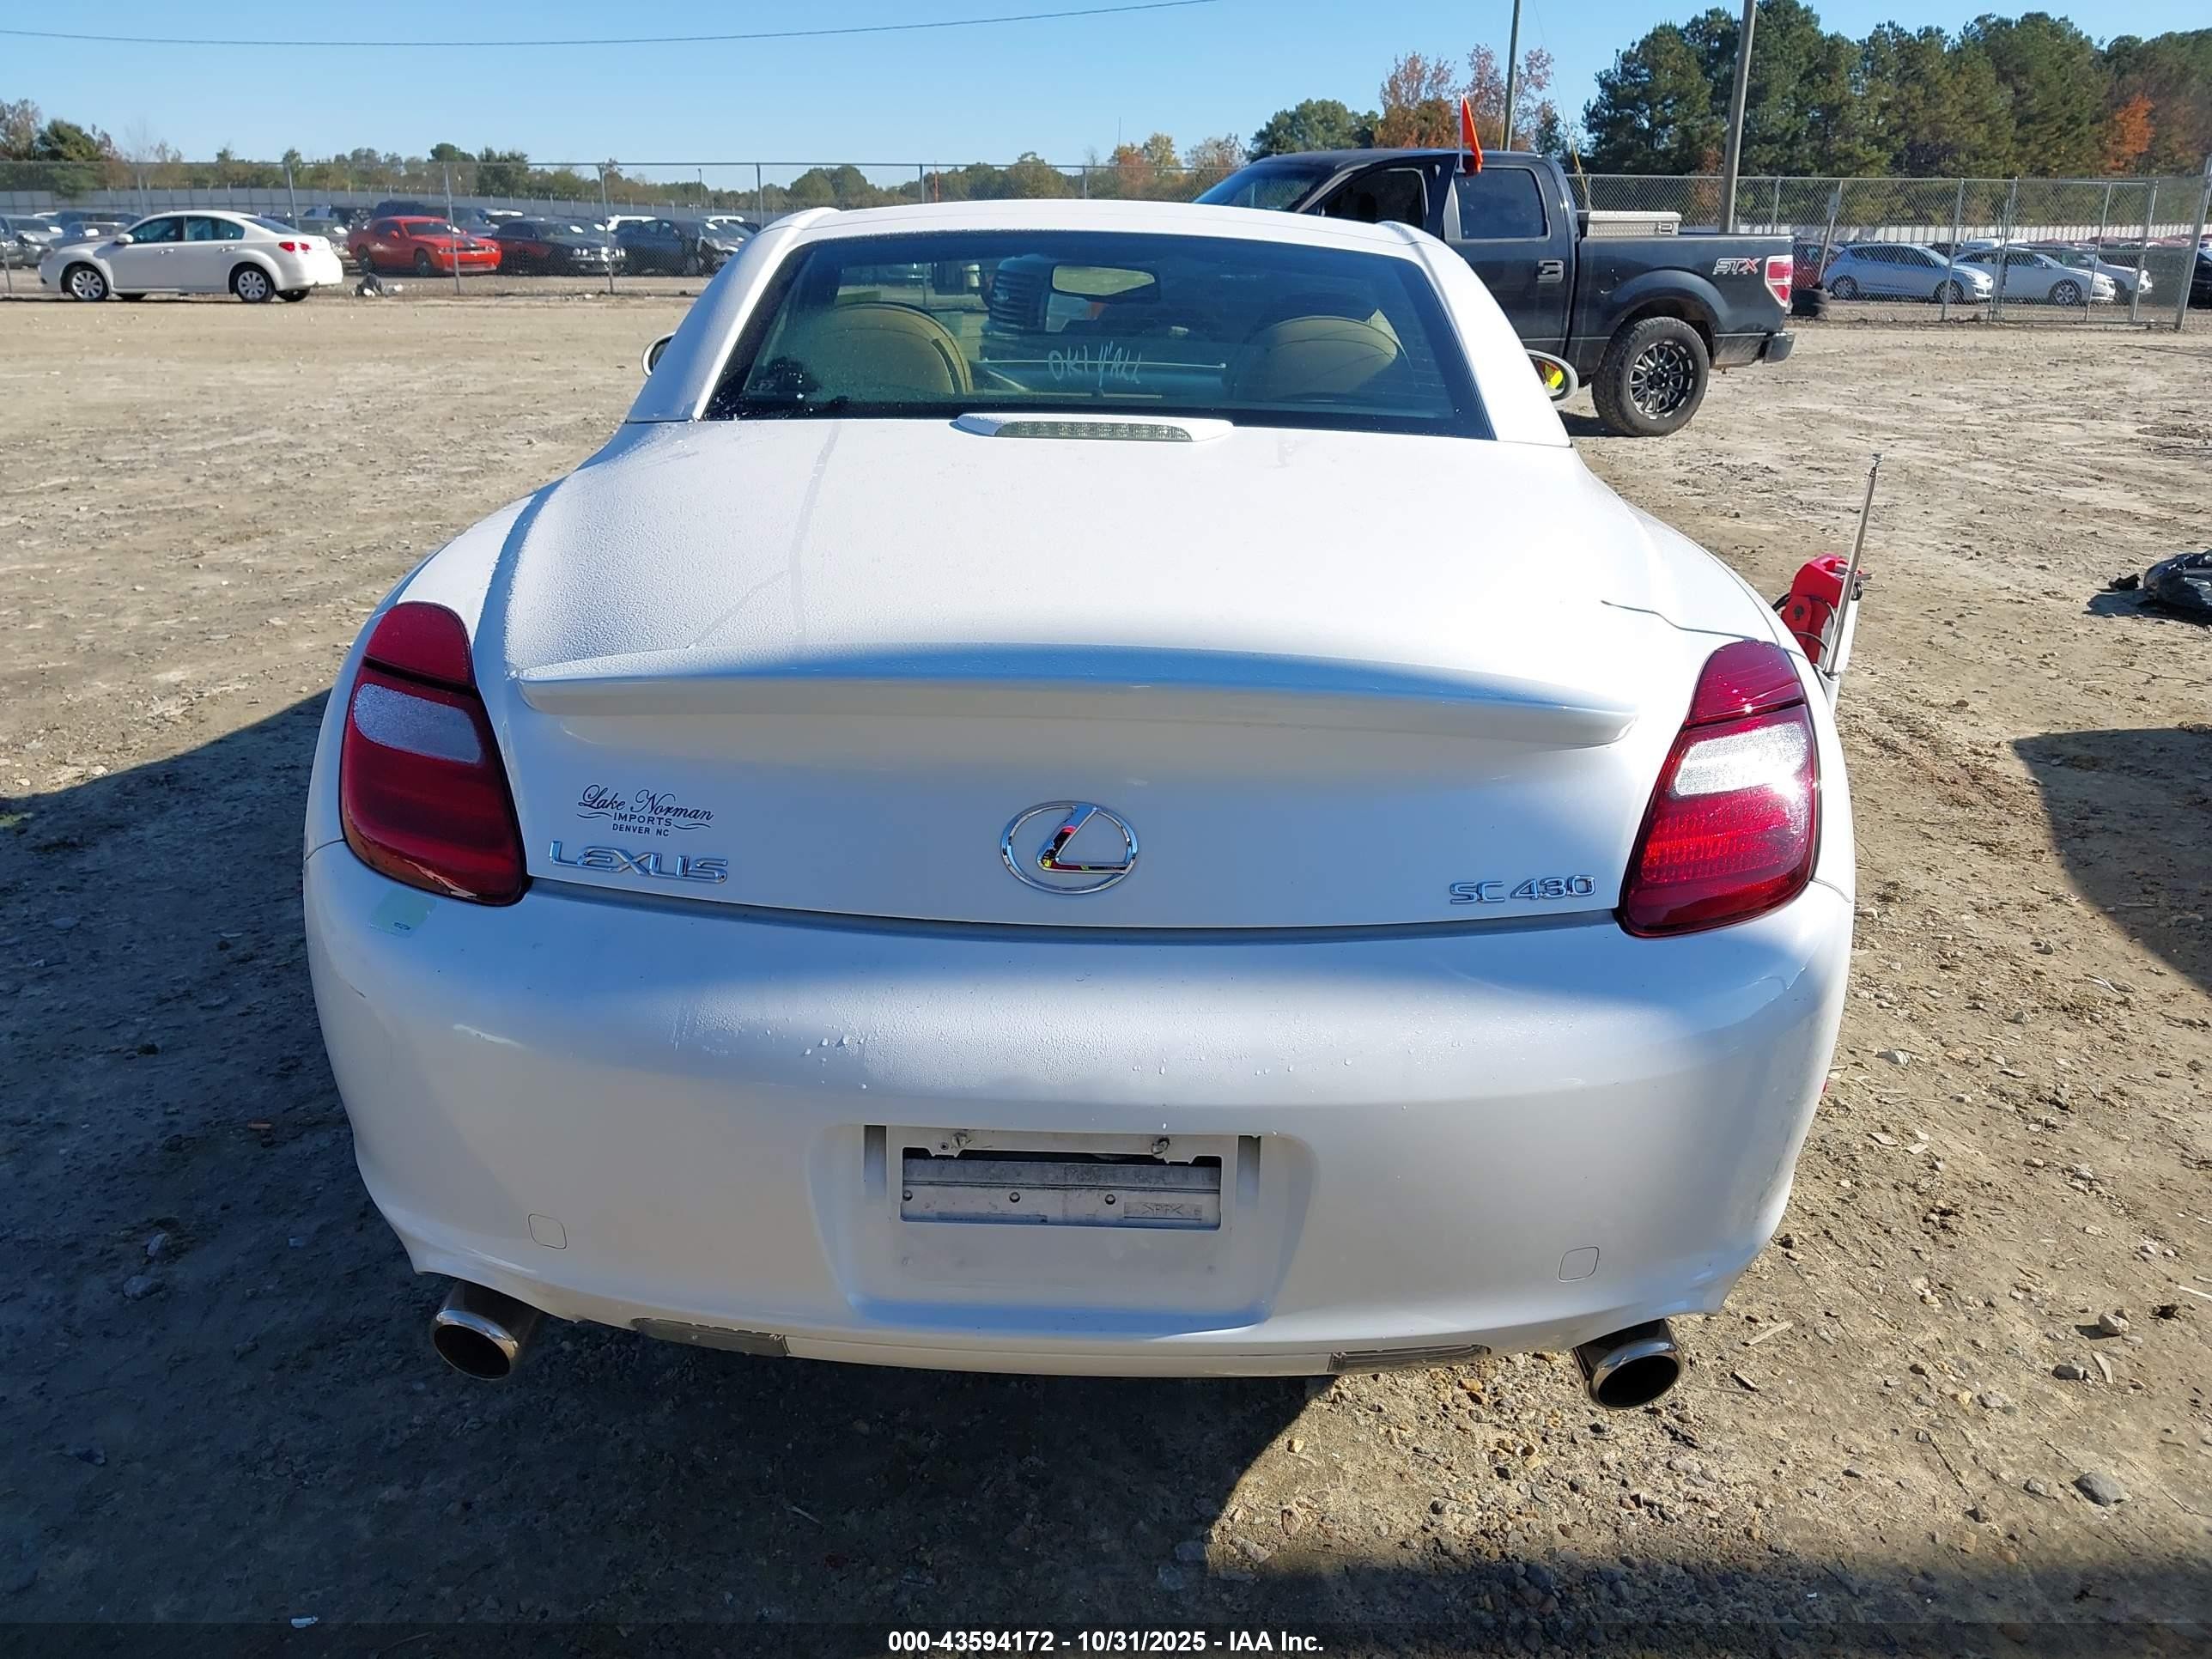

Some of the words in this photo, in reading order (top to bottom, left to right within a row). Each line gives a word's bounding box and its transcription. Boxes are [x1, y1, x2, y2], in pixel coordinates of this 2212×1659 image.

[1712, 257, 1763, 272] STX
[577, 784, 626, 811] Lake
[630, 788, 714, 821] Norman
[611, 823, 650, 835] DENVER
[655, 828, 670, 837] NC
[612, 811, 672, 827] IMPORTS
[549, 840, 728, 884] LEXUS
[1449, 880, 1505, 905] SC
[1510, 874, 1596, 900] 430
